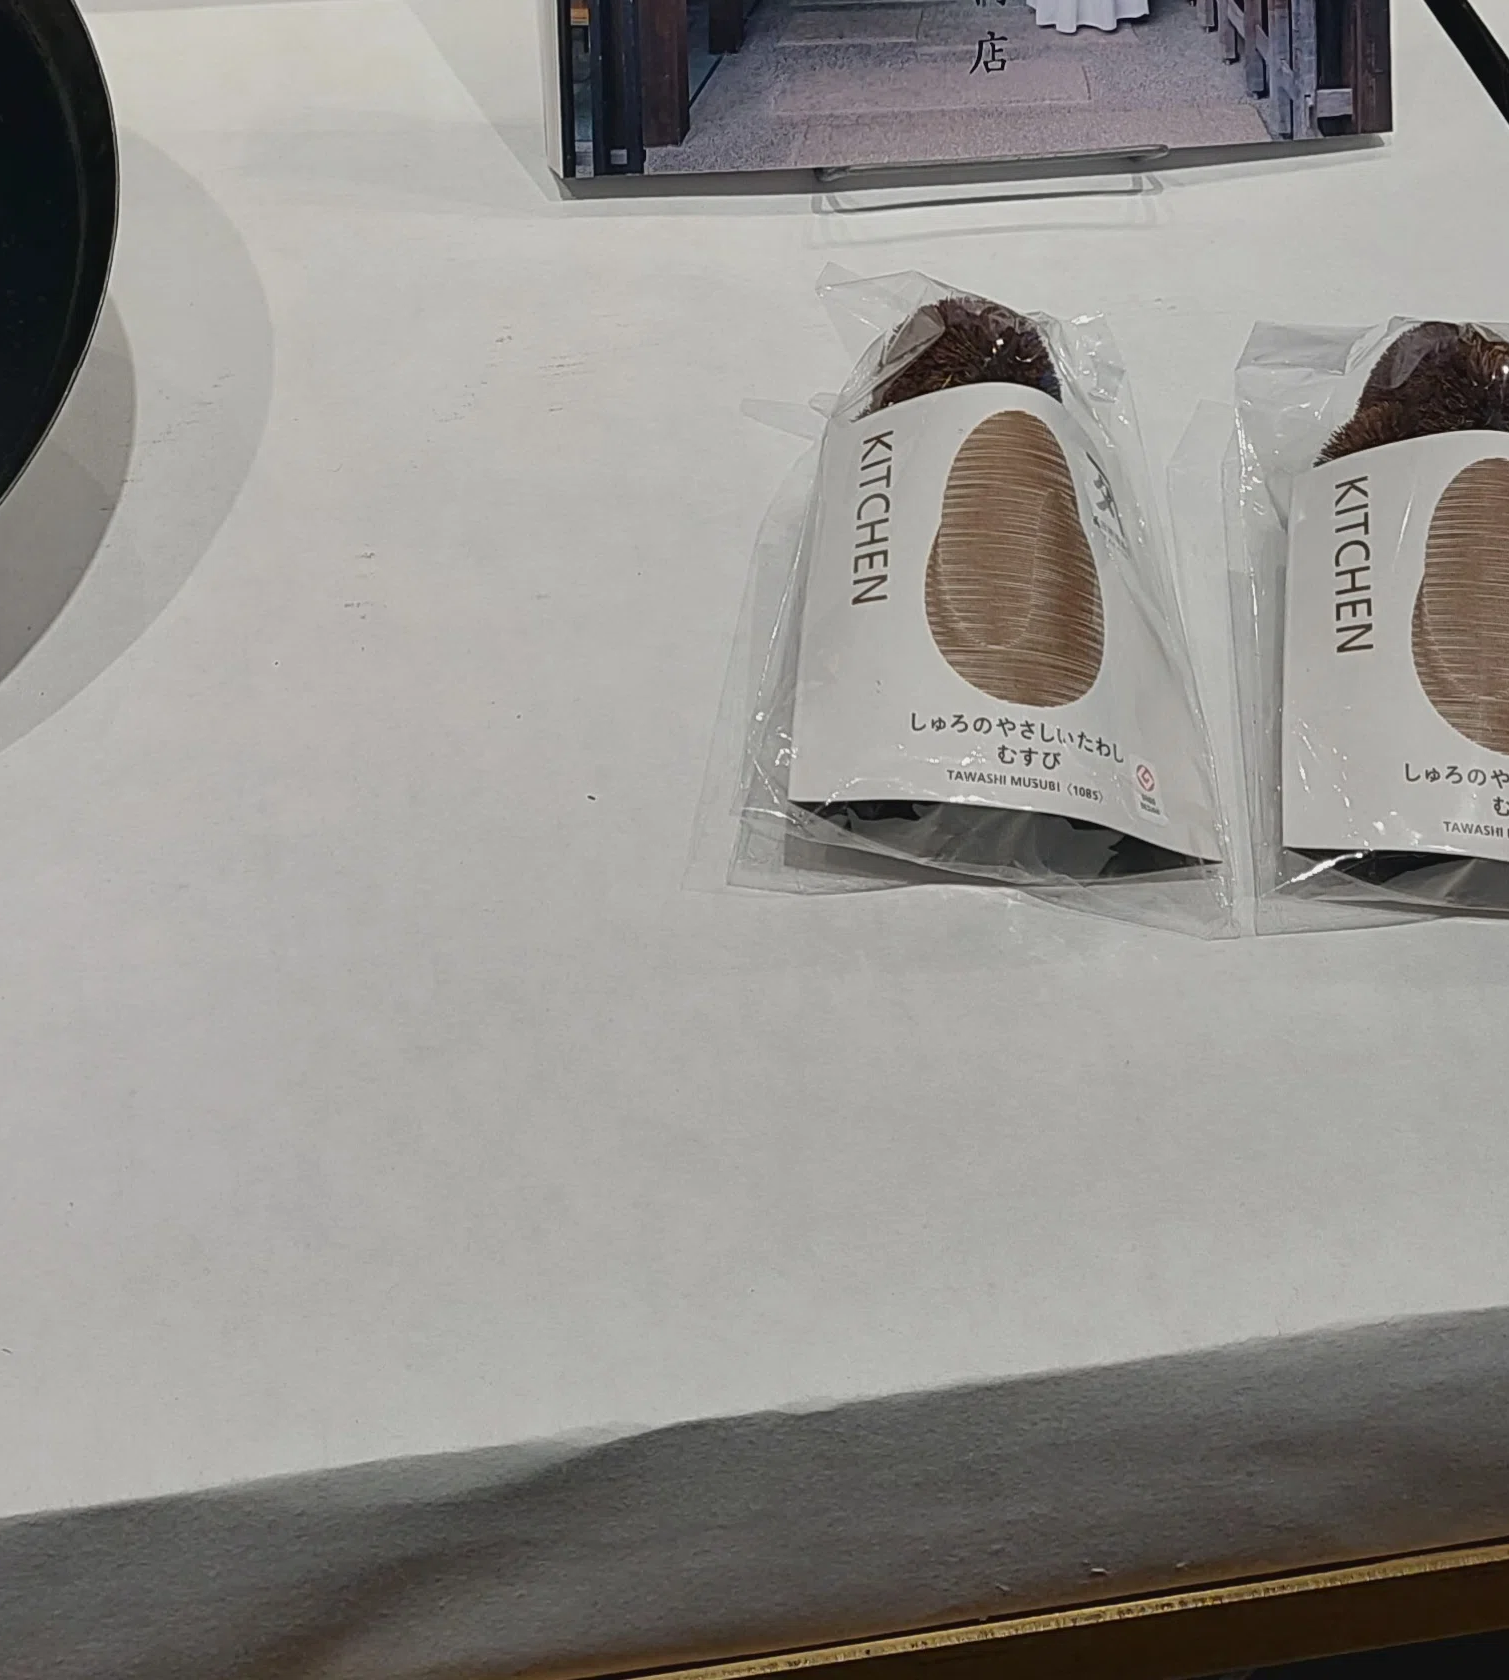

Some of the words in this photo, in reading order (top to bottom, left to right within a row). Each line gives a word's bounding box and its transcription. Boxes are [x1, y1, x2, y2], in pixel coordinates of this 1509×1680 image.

[851, 430, 894, 606] KITCHEN
[1333, 475, 1375, 655] KITCHEN
[909, 711, 1124, 764] しゅろのやさしいたわし
[997, 744, 1062, 770] むすび
[946, 768, 1007, 788] TAWASHI
[1010, 775, 1061, 793] MUSUBI
[1443, 821, 1504, 839] TAWASHI
